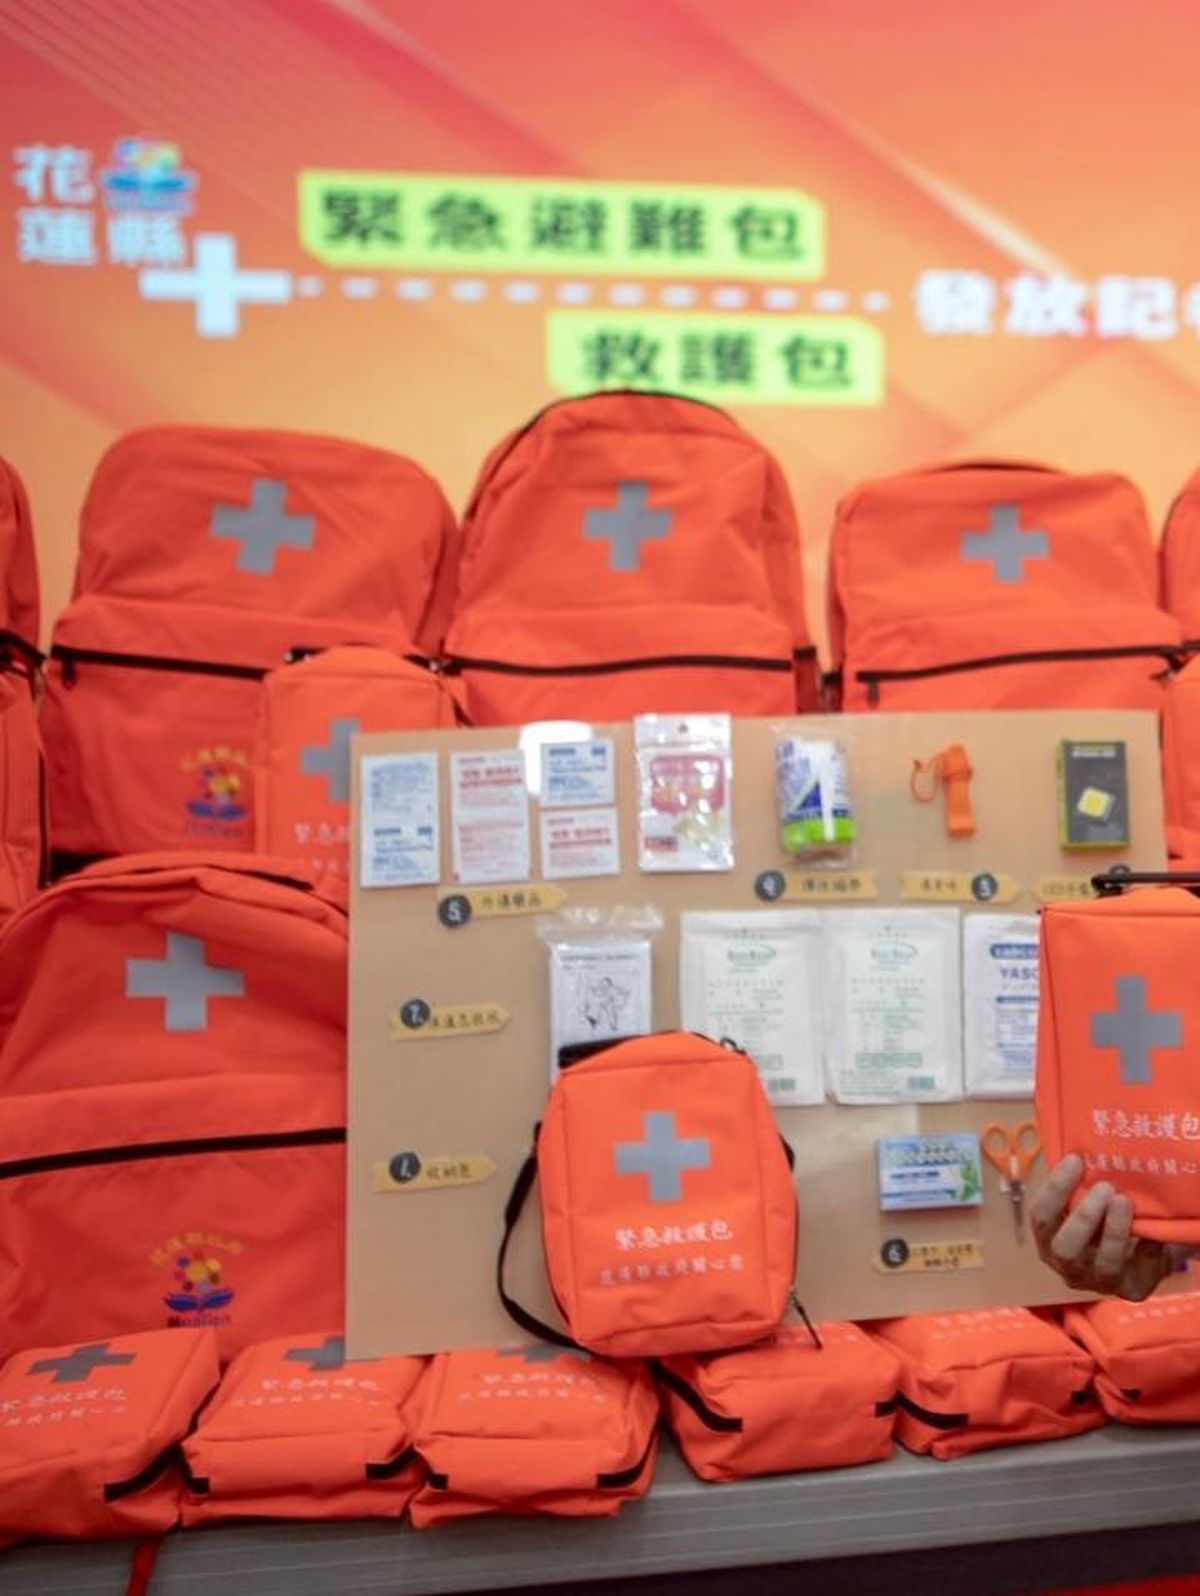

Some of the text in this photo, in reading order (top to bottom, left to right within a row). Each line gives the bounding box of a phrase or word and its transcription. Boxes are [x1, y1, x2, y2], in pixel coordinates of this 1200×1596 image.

[13, 143, 96, 202] 花
[320, 188, 804, 261] 緊急避難包
[582, 330, 853, 389] 救護包
[614, 1218, 734, 1251] 緊急救護包
